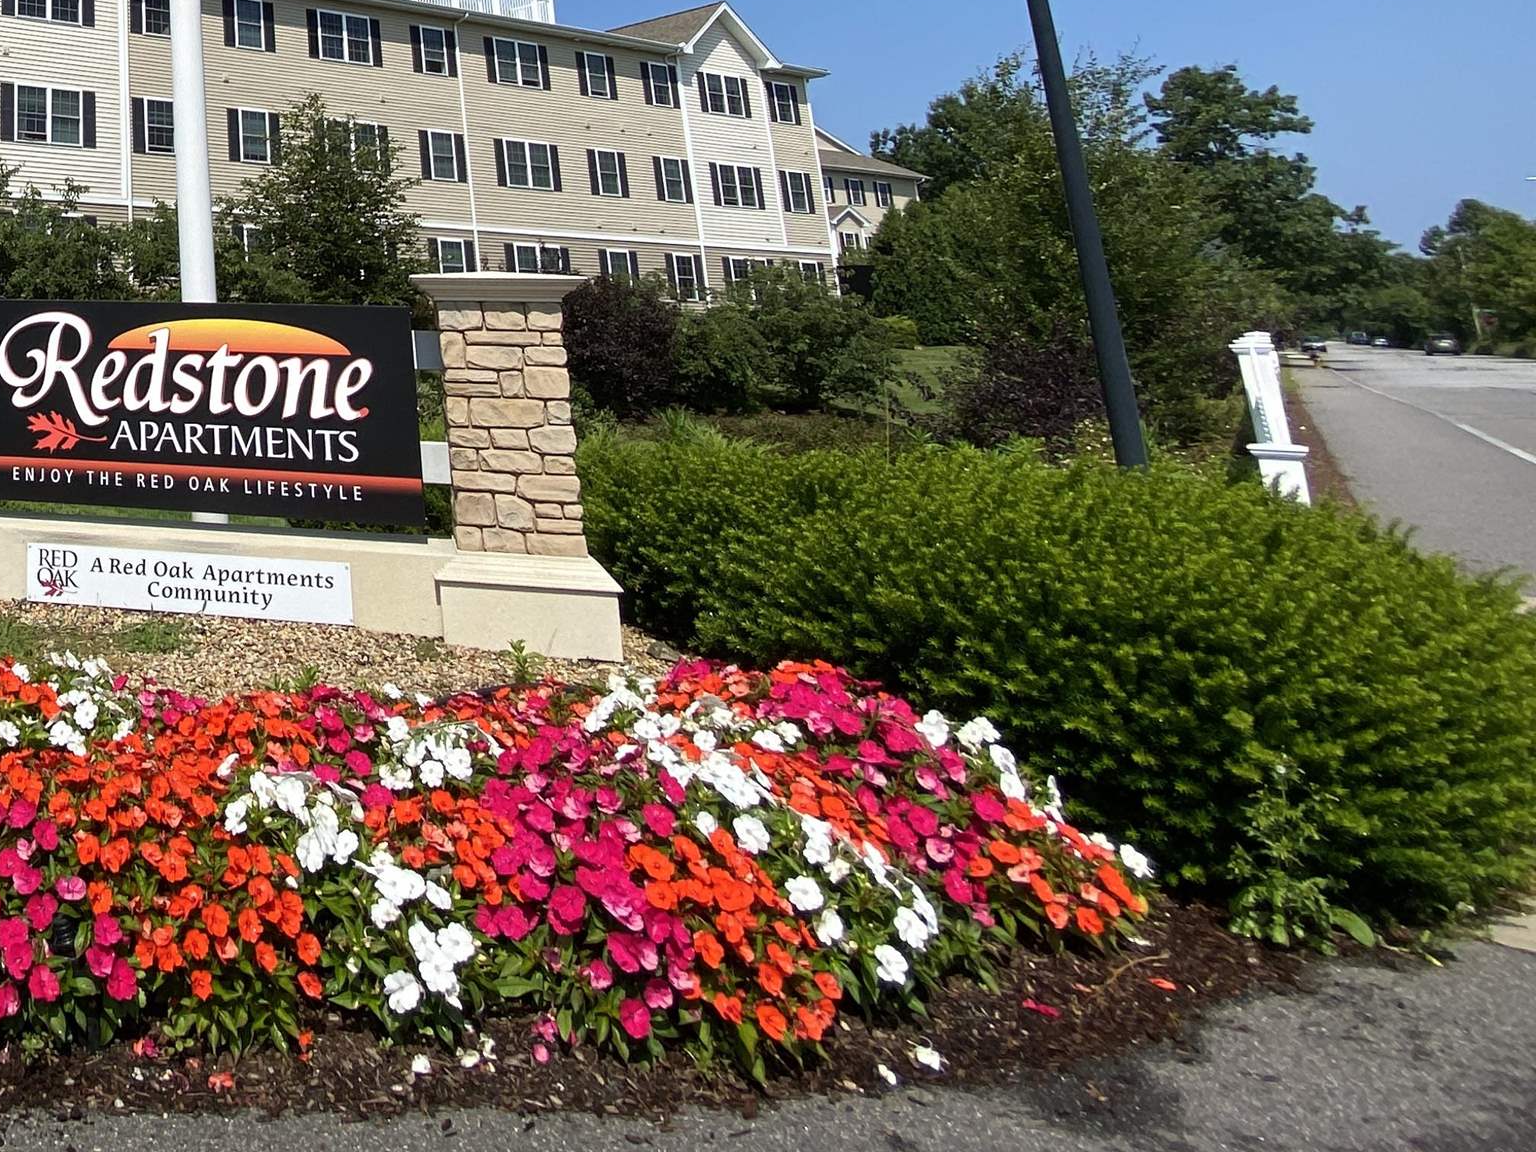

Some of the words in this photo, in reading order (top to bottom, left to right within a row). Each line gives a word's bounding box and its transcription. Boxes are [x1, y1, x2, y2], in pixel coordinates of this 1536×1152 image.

[109, 419, 359, 463] APARTMENTS
[12, 466, 74, 484] ENJOY
[86, 471, 123, 487] THE
[137, 474, 175, 490] RED
[188, 477, 230, 494] OAK
[244, 481, 364, 502] LIFESTYLE
[38, 548, 78, 569] RED
[90, 557, 105, 574] A
[109, 558, 147, 578] Red
[153, 561, 194, 580] Oak
[202, 564, 335, 590] Apartments
[36, 566, 79, 589] OAK
[147, 581, 272, 611] Community
